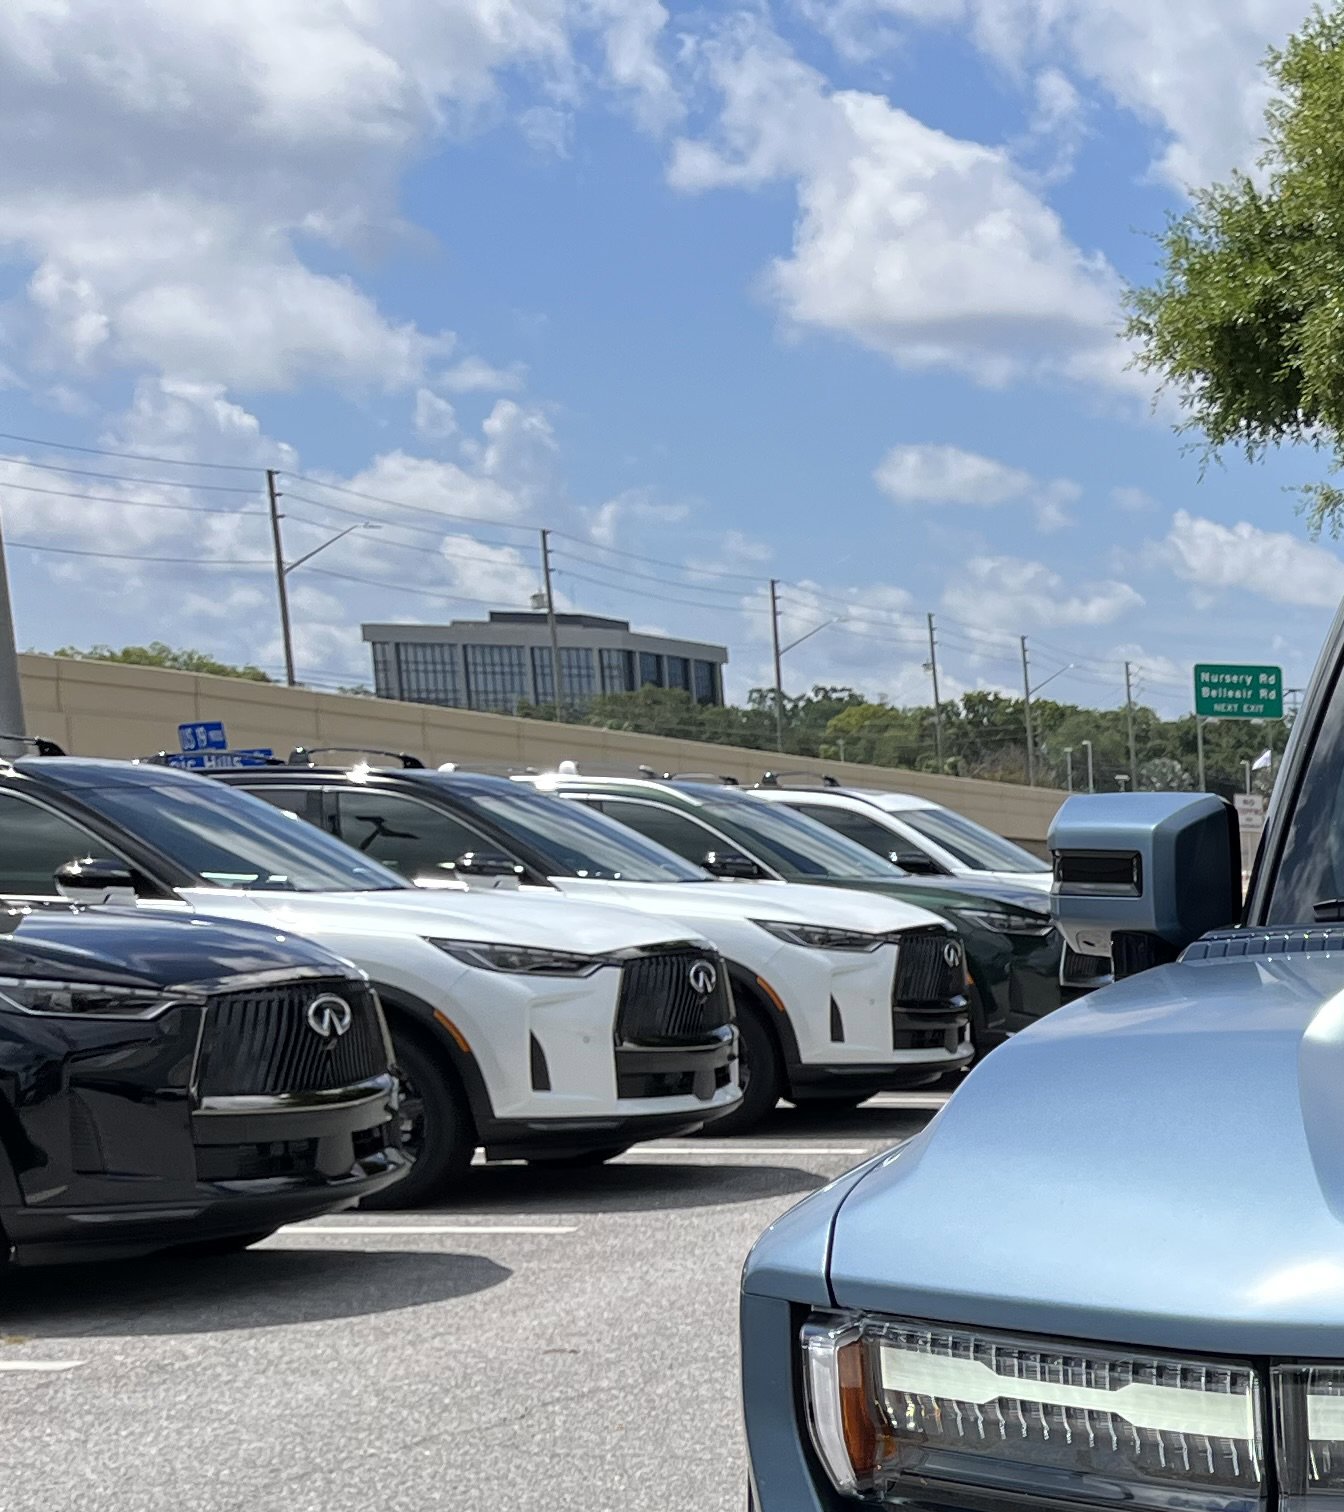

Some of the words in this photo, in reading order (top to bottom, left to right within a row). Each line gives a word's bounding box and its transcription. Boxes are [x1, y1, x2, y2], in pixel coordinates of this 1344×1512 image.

[1200, 672, 1253, 686] Nursery
[1259, 673, 1276, 685] Rd
[1201, 686, 1253, 699] Belleair
[1259, 688, 1277, 700] Rd
[1213, 703, 1238, 713] NEXT
[1243, 703, 1264, 713] EXIT
